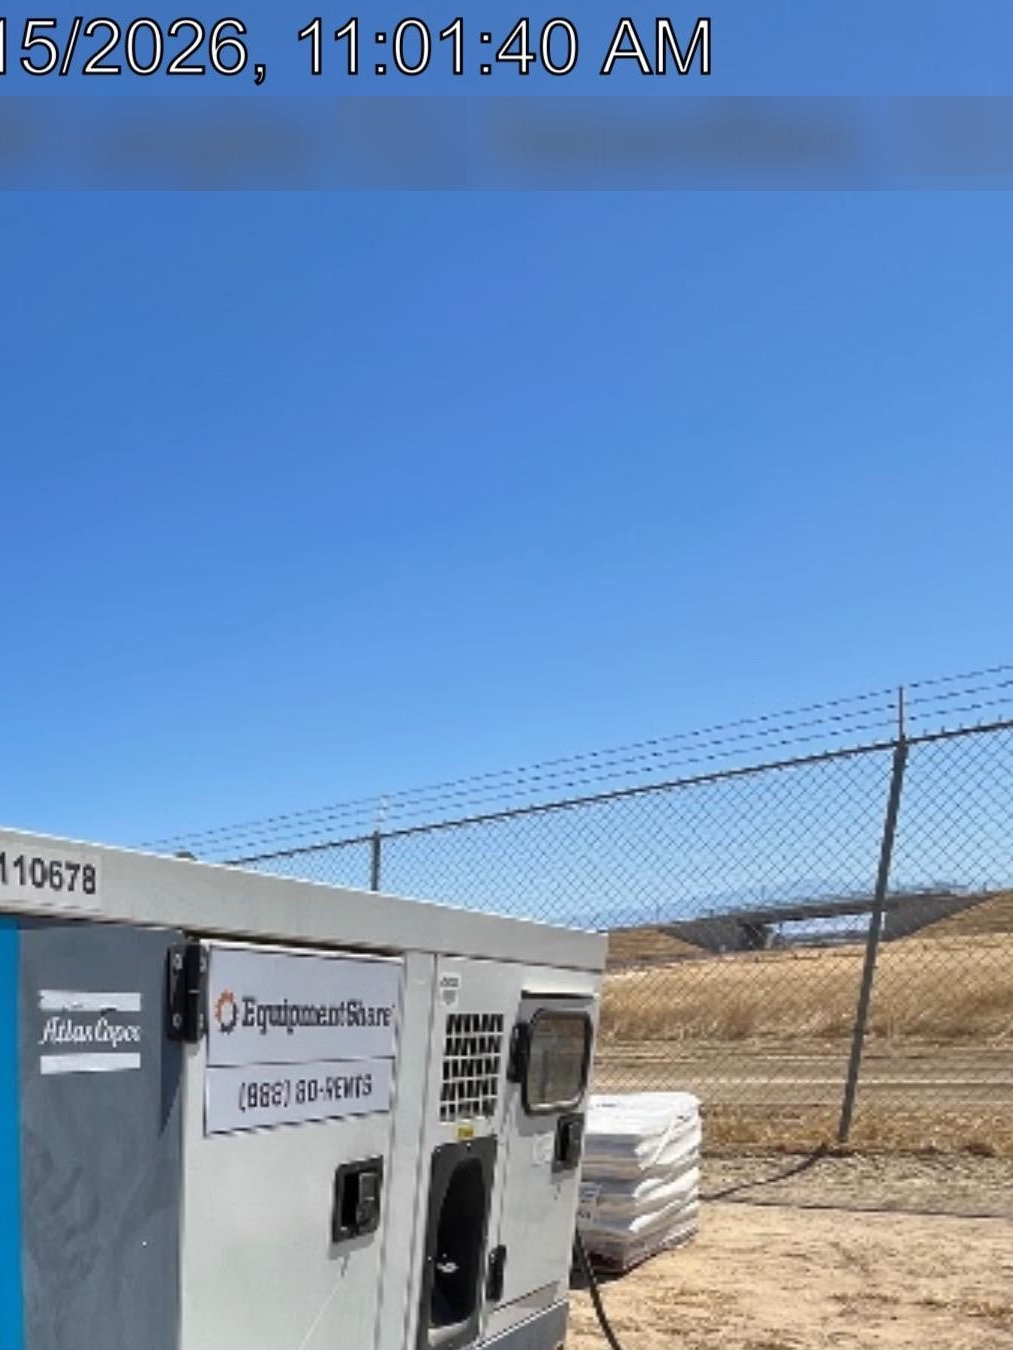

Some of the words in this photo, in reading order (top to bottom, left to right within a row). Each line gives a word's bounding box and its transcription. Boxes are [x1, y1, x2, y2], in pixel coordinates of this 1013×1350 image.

[38, 1016, 93, 1044] Atlas
[94, 1016, 141, 1048] Copco
[242, 996, 391, 1034] EquipmentShare
